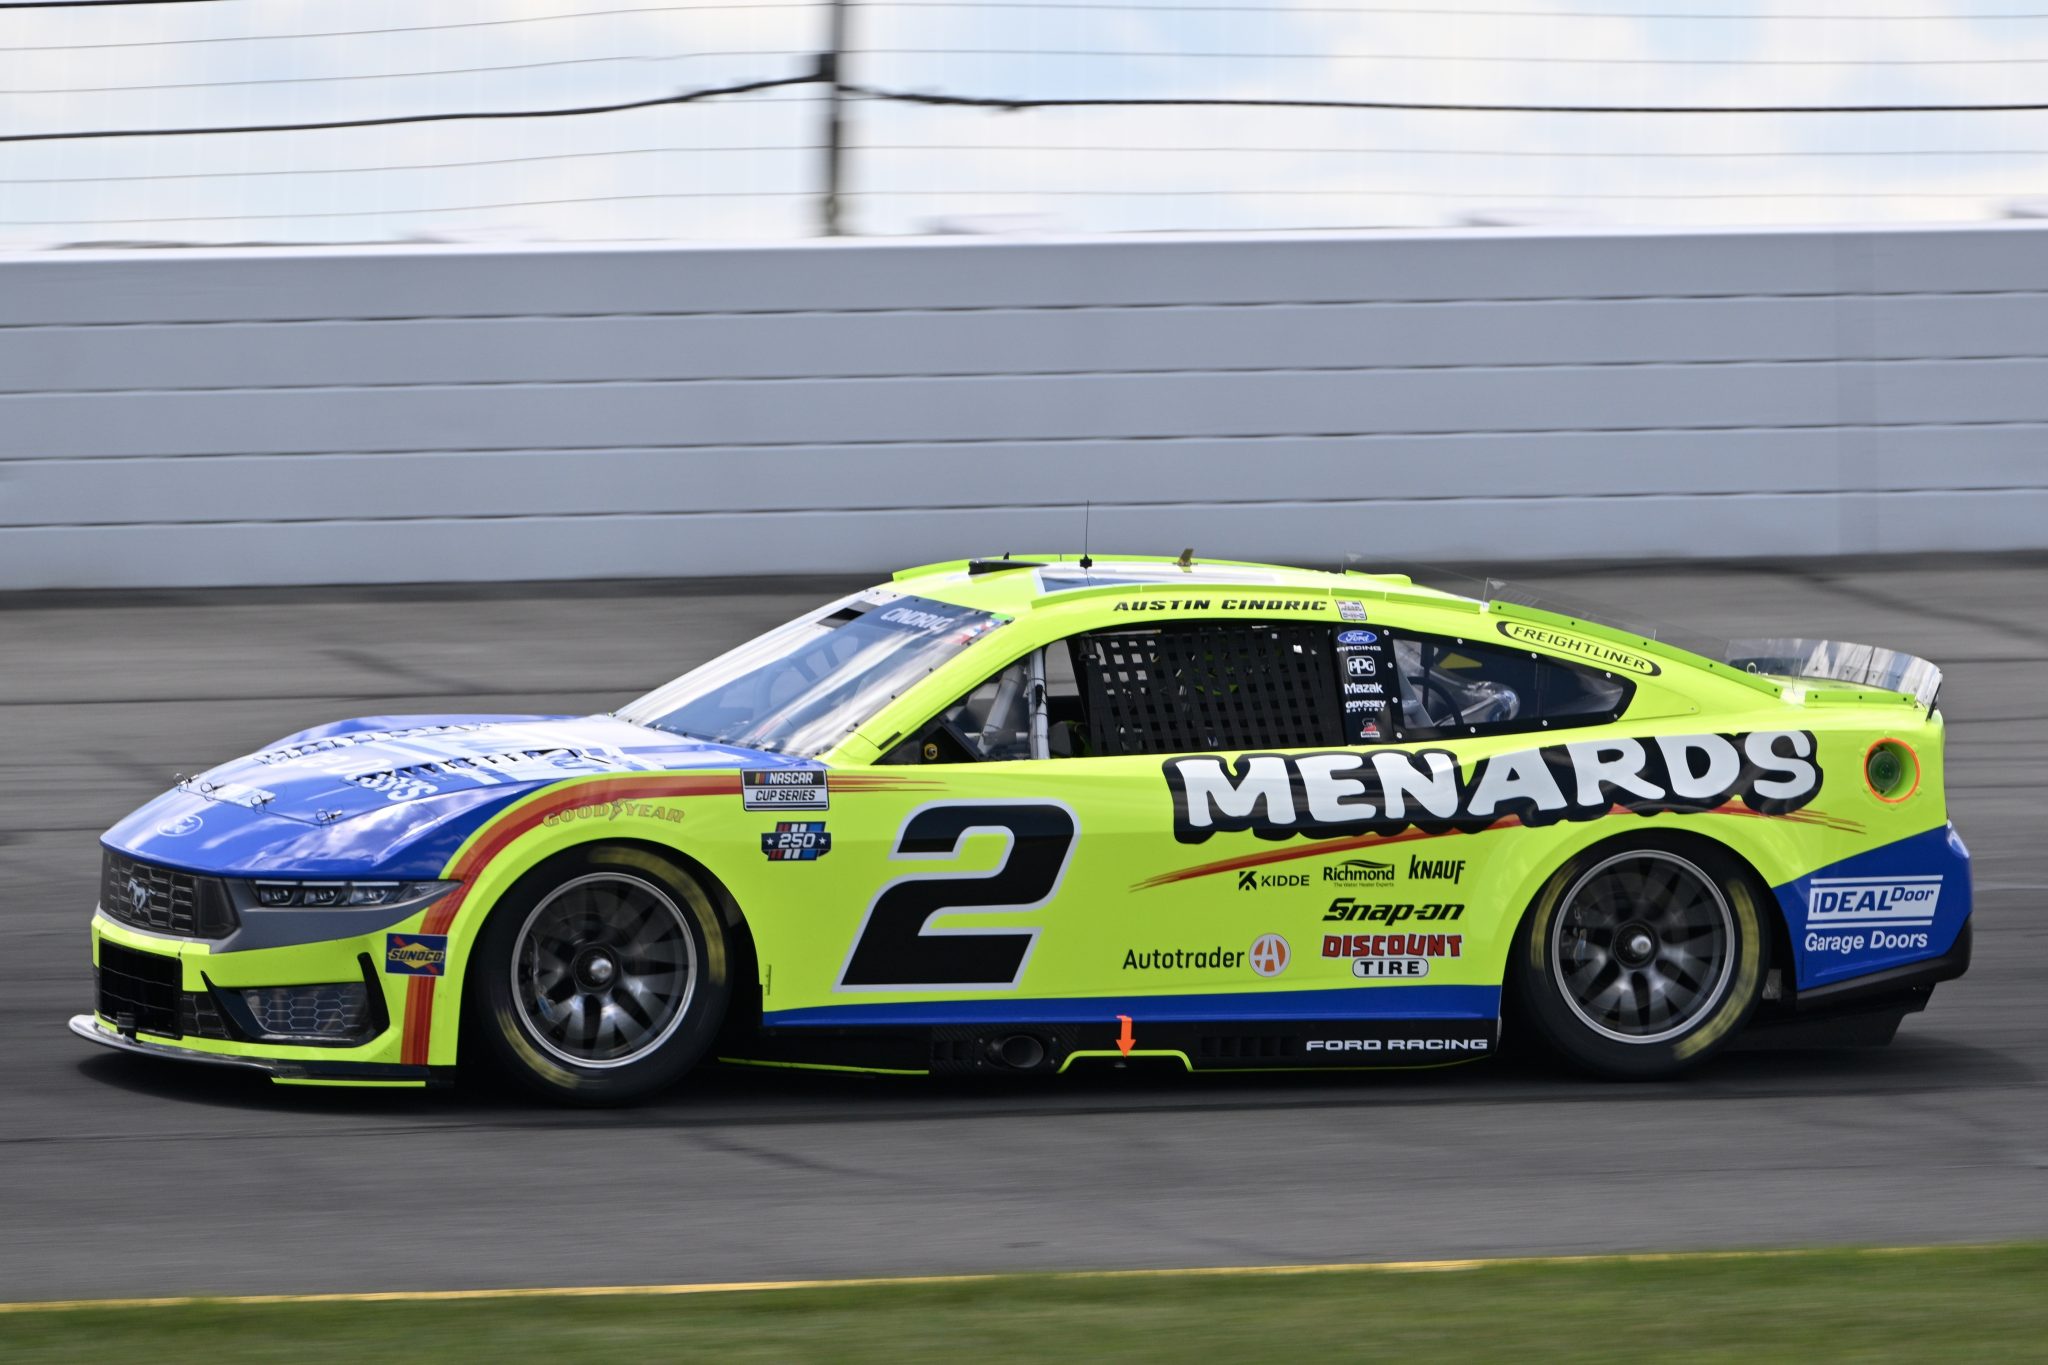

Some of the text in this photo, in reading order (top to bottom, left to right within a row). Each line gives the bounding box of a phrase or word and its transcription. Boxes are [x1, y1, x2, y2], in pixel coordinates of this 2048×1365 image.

[1113, 599, 1210, 611] AUSTIN
[1220, 599, 1328, 611] CINDRIC
[1513, 626, 1645, 670] FREIGHTLINER
[1349, 658, 1374, 674] PPG
[1344, 682, 1384, 695] Mazak
[1345, 700, 1386, 708] ODYSSEY
[769, 772, 814, 784] NASCAR
[1172, 729, 1819, 832] MENARDS
[755, 789, 816, 801] CUP SERIES
[542, 802, 686, 828] GOODYEAR
[778, 833, 816, 849] 250
[1261, 874, 1310, 887] KIDDE
[1323, 864, 1395, 881] Richmond
[837, 801, 1078, 989] 2
[1322, 897, 1465, 926] Snap-on
[1321, 933, 1463, 958] DISCOUNT
[1805, 930, 1928, 954] Garage Doors
[390, 949, 443, 962] SUNOCO
[1122, 946, 1245, 970] Autotrader
[1360, 961, 1420, 975] TIRE
[1306, 1039, 1488, 1051] FORD RACING
